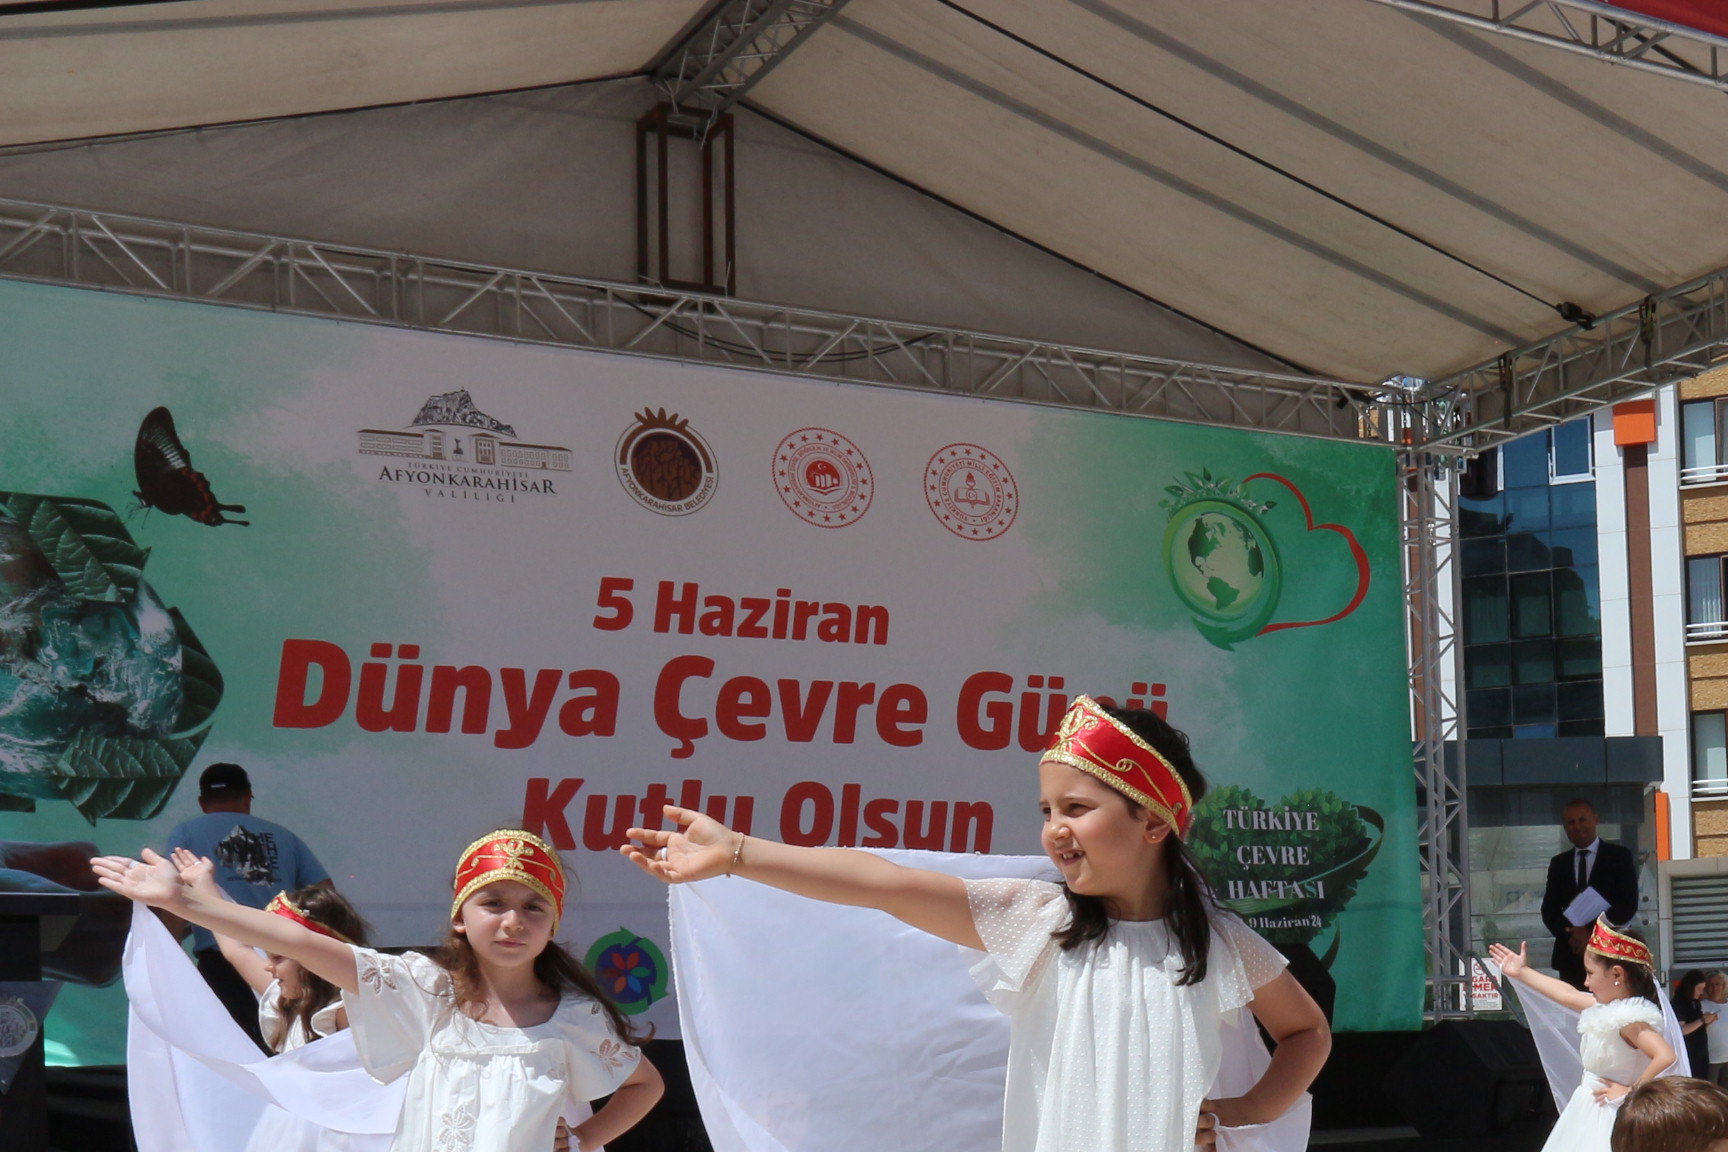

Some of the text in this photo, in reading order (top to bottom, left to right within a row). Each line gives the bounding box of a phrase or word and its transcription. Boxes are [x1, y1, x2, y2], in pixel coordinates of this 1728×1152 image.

[379, 465, 558, 495] AFYONKARAHİSAR
[407, 461, 529, 479] TÜRKİYE CUMHURİYETİ
[424, 488, 516, 504] VALİLİĞİ
[621, 466, 714, 513] AFYONKARAHİSAR BELEDİYESİ
[592, 576, 890, 646] 5 Haziran
[272, 638, 621, 750] Dünya
[653, 653, 929, 760] Çevre
[779, 780, 995, 854] Olsun
[1223, 805, 1320, 831] TÜRKİYE
[1236, 845, 1311, 871] ÇEVRE
[1227, 880, 1326, 900] HAFTASI
[1248, 918, 1257, 929] 9
